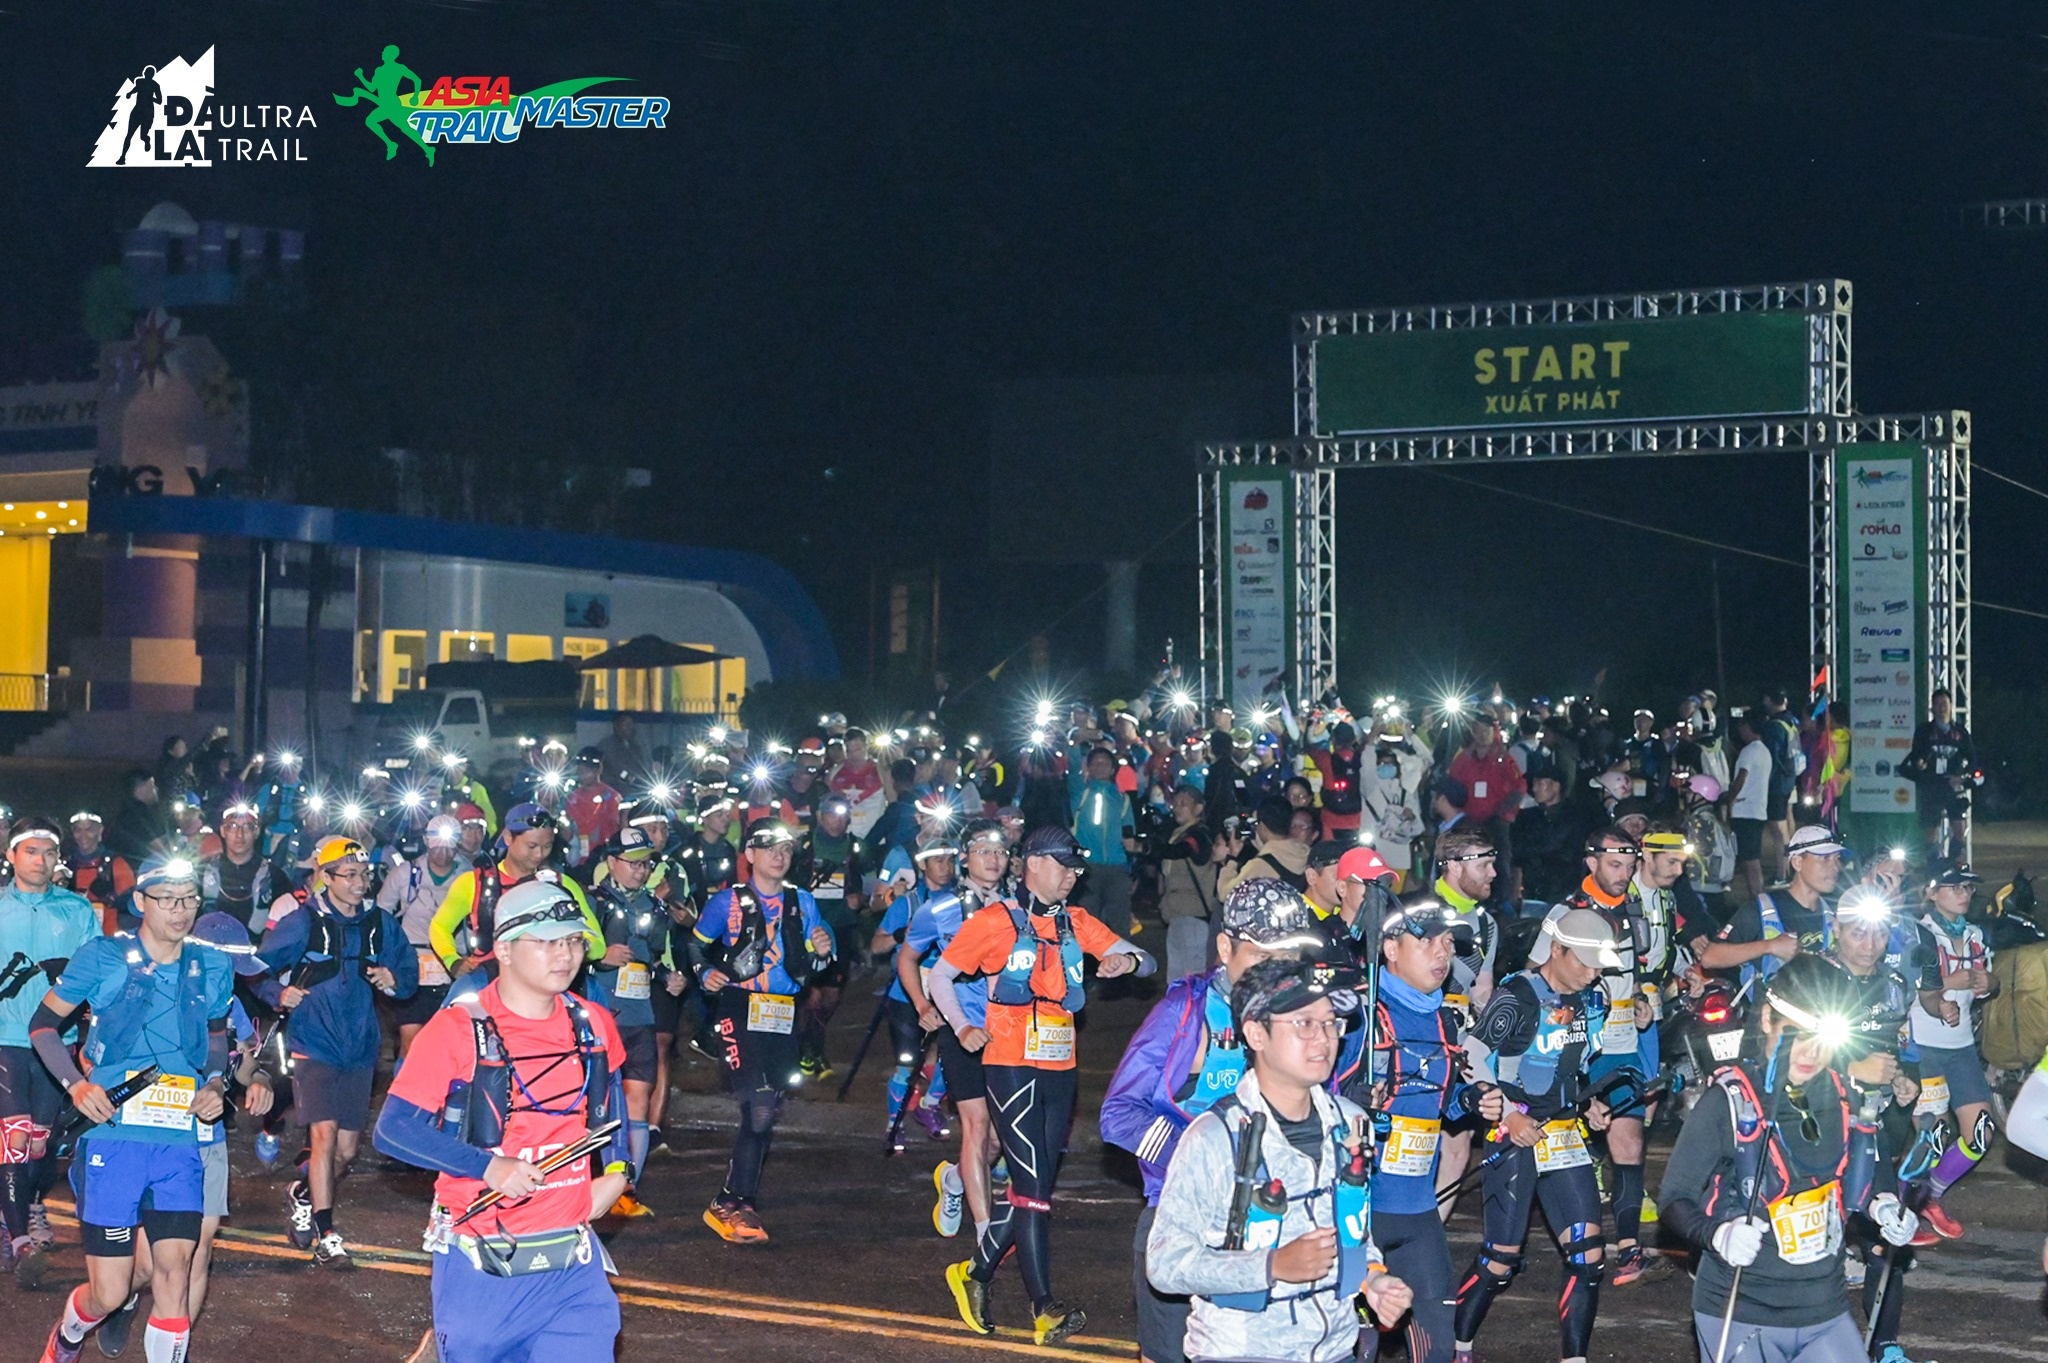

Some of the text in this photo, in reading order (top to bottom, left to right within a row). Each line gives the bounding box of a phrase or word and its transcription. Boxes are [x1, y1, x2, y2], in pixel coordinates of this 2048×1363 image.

[1474, 341, 1630, 385] START
[1484, 385, 1621, 414] XUẤT PHÁT
[149, 1088, 189, 1105] 70103
